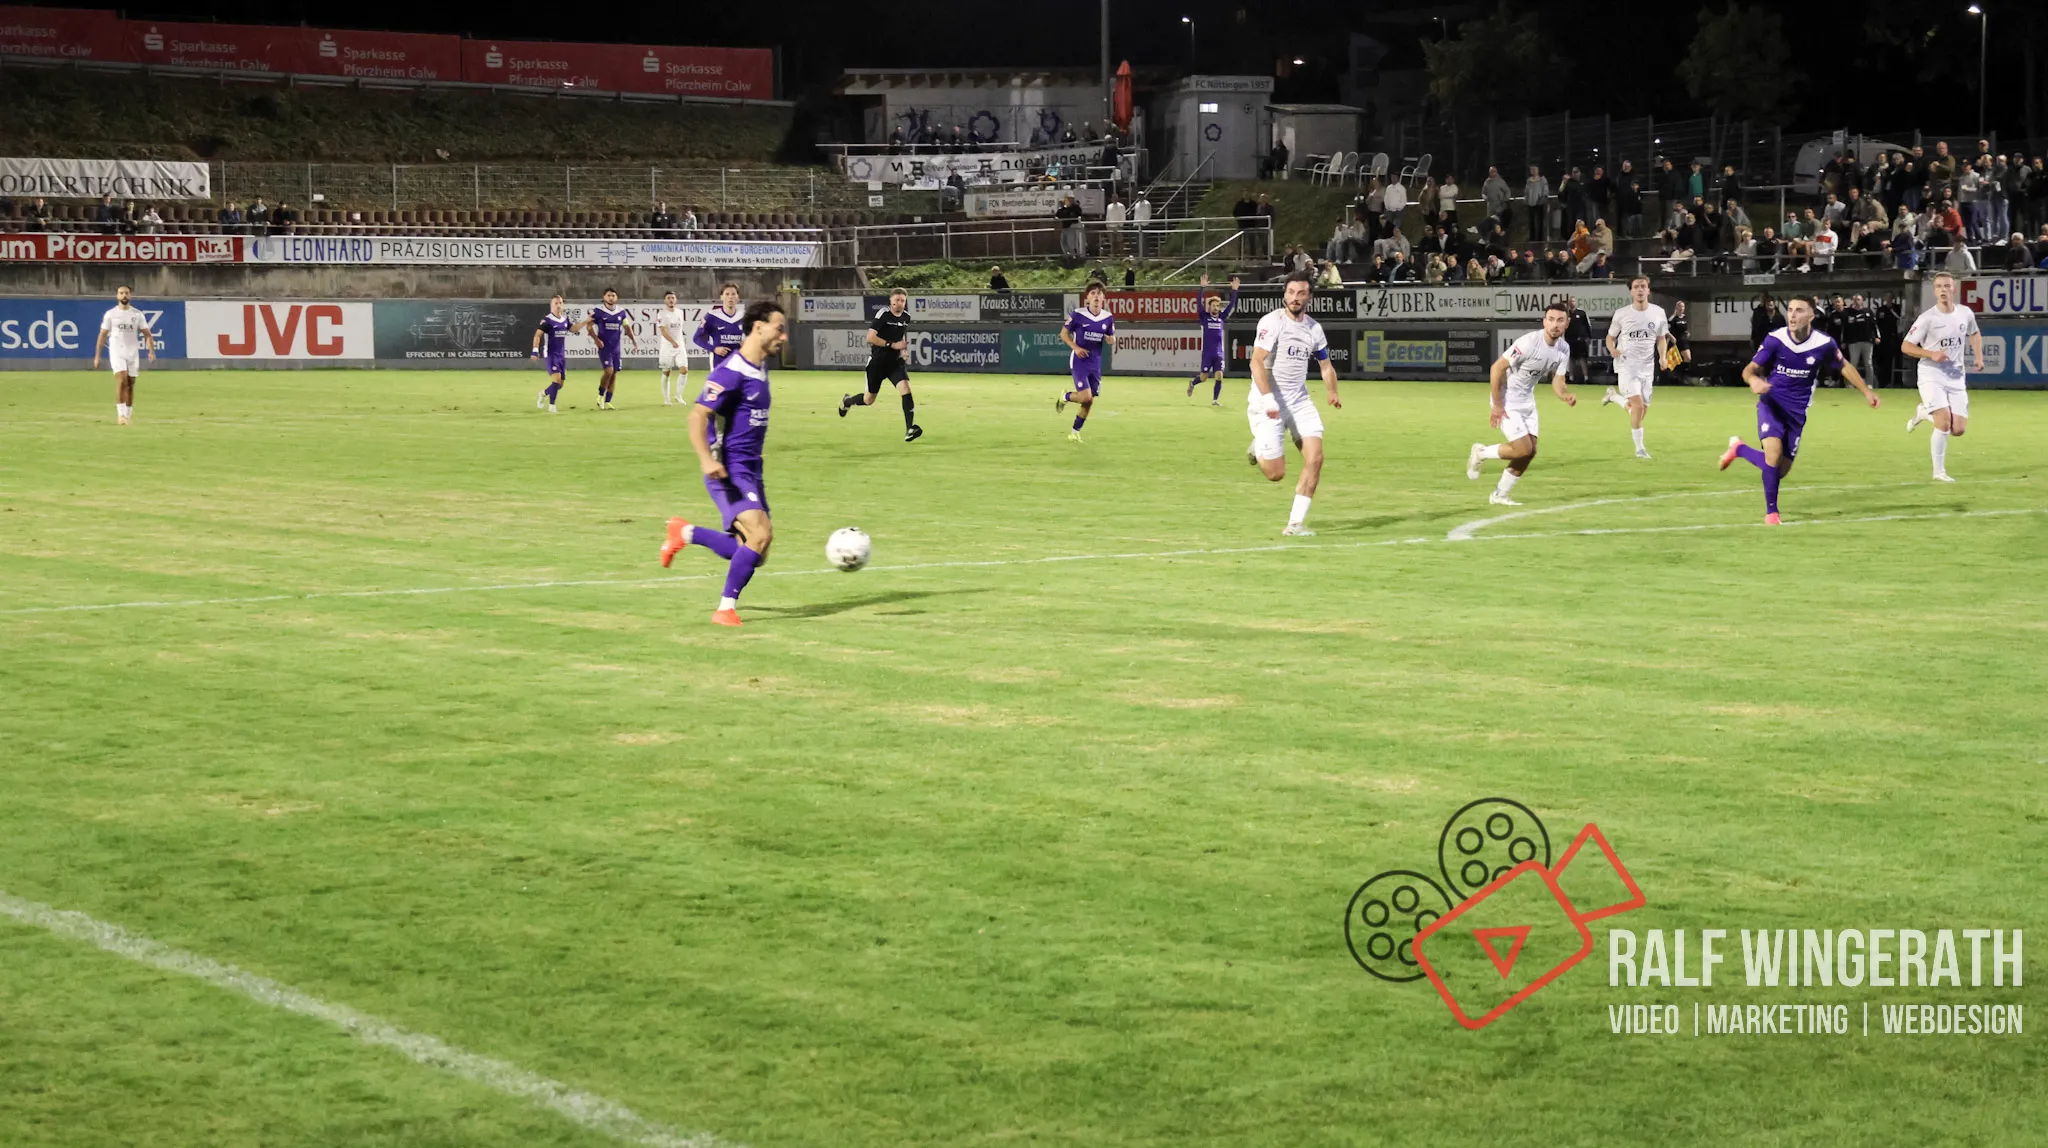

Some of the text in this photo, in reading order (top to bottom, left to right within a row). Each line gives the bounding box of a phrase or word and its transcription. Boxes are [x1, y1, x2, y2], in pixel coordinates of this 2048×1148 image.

[169, 40, 237, 54] Sparkasse
[343, 46, 407, 61] Sparkasse
[343, 63, 438, 79] Pforzheim Calw
[509, 57, 568, 70] Sparkasse
[665, 61, 723, 75] Sparkasse
[665, 78, 752, 92] Pforzheim Calw
[1195, 80, 1206, 89] FC
[1250, 80, 1270, 89] 1957
[47, 235, 188, 260] Pforzheim
[283, 238, 585, 262] LEONHARD PRÄZISIONSTEILE GMBH
[641, 244, 733, 254] KOMMUNIKATIONSTECHNIK
[653, 255, 683, 263] Norbert
[685, 256, 707, 264] Kolbe
[714, 256, 800, 265] www.kws-komtech.de
[980, 294, 1046, 310] Krauss & Söhne
[1989, 278, 2044, 313] GÜL
[815, 299, 857, 313] Volksbank pur
[927, 297, 972, 312] Volksbank pur
[1335, 297, 1354, 313] e.K.
[1576, 296, 1633, 311] ENSTERBA
[1714, 296, 1737, 314] ETL
[218, 304, 344, 356] JVC
[1629, 331, 1649, 339] GEA
[932, 332, 1000, 344] SICHERHEITSDIENST
[1033, 333, 1067, 346] nonne
[1114, 334, 1179, 356] jentnergroup
[405, 351, 523, 359] EFFICIENCY IN CARBIDE MATTERS
[564, 347, 597, 356] mmobil
[933, 348, 1000, 367] F-G-Security.de
[1386, 342, 1444, 361] Getsch
